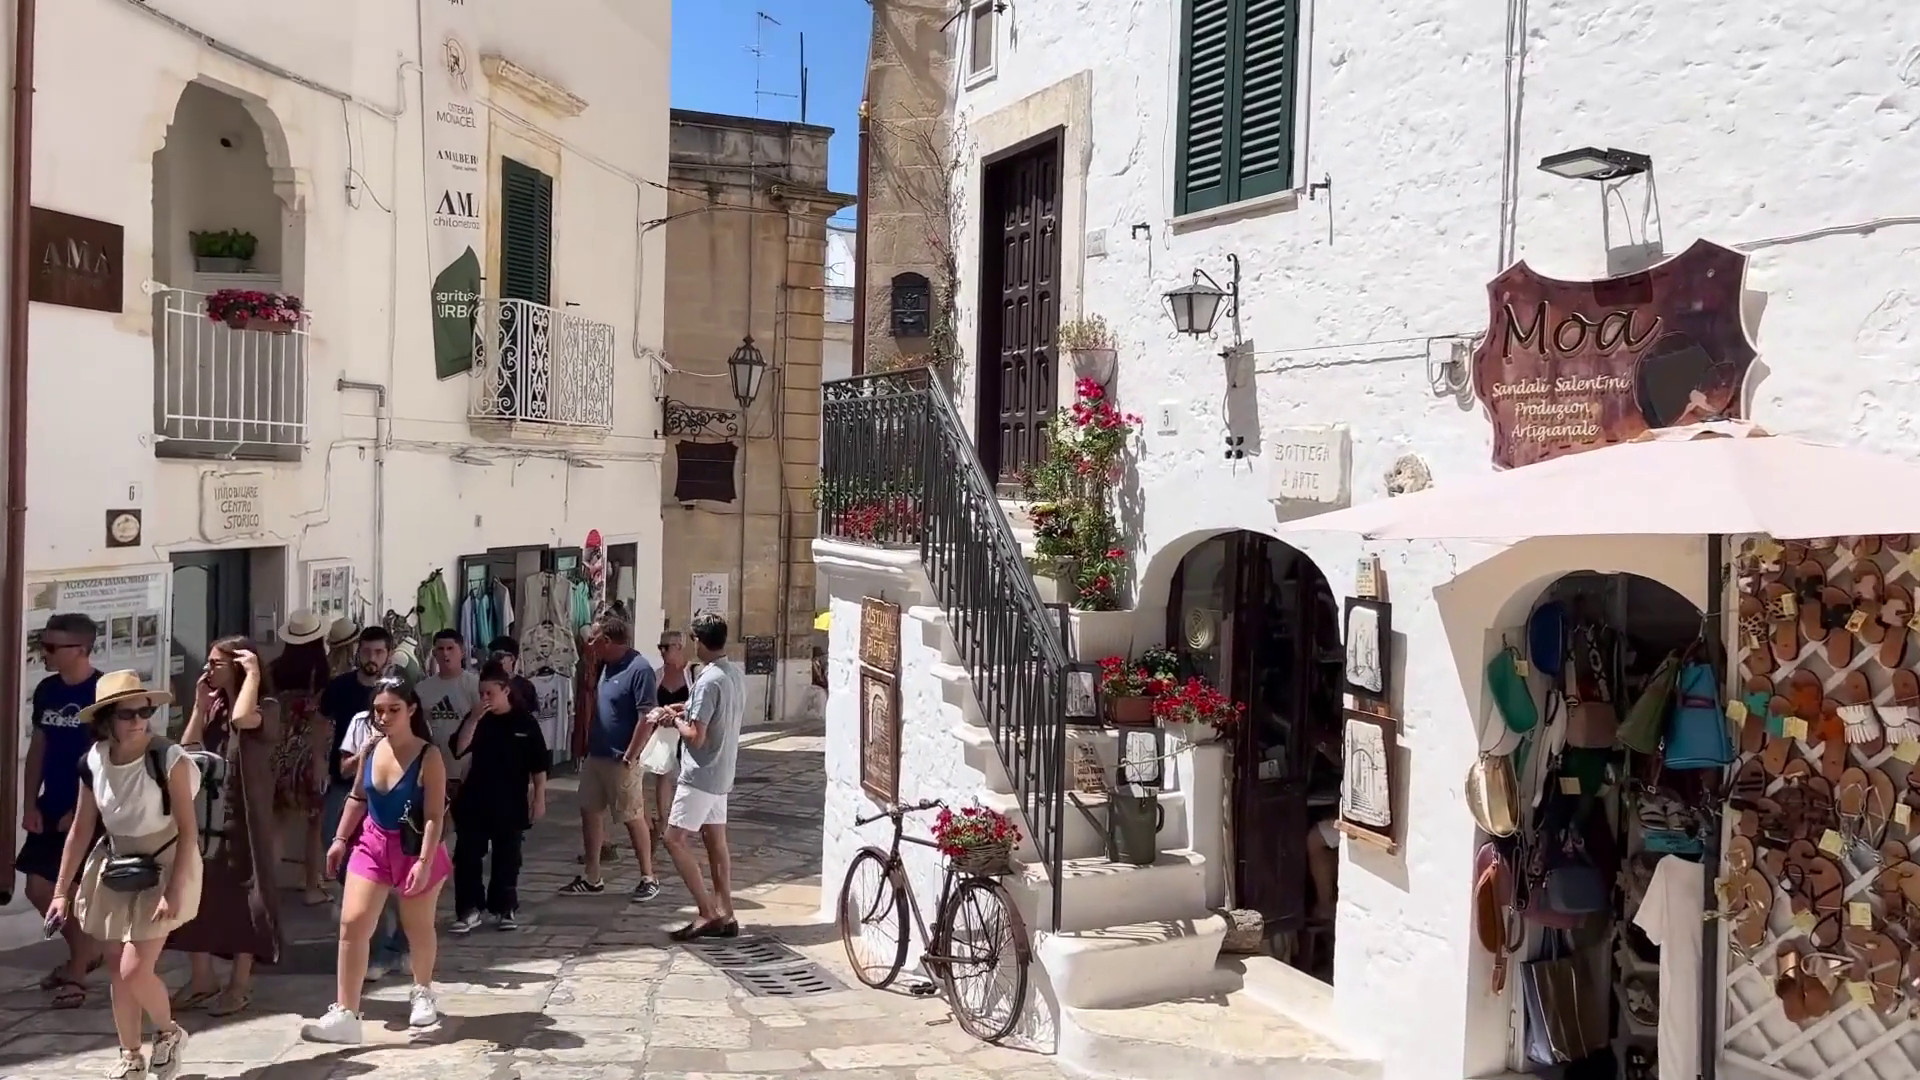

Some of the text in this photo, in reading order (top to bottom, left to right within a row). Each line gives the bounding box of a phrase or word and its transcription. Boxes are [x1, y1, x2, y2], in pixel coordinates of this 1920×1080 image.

[43, 237, 111, 274] AMA
[1502, 299, 1662, 361] Moa
[1492, 372, 1631, 398] Sandali Salentini
[1163, 409, 1169, 428] 5
[1511, 420, 1600, 441] Artigianale
[1274, 443, 1330, 462] BOTTEGA
[220, 499, 252, 514] CENTRO
[223, 513, 260, 530] STORICO
[866, 606, 892, 629] OSTUNI
